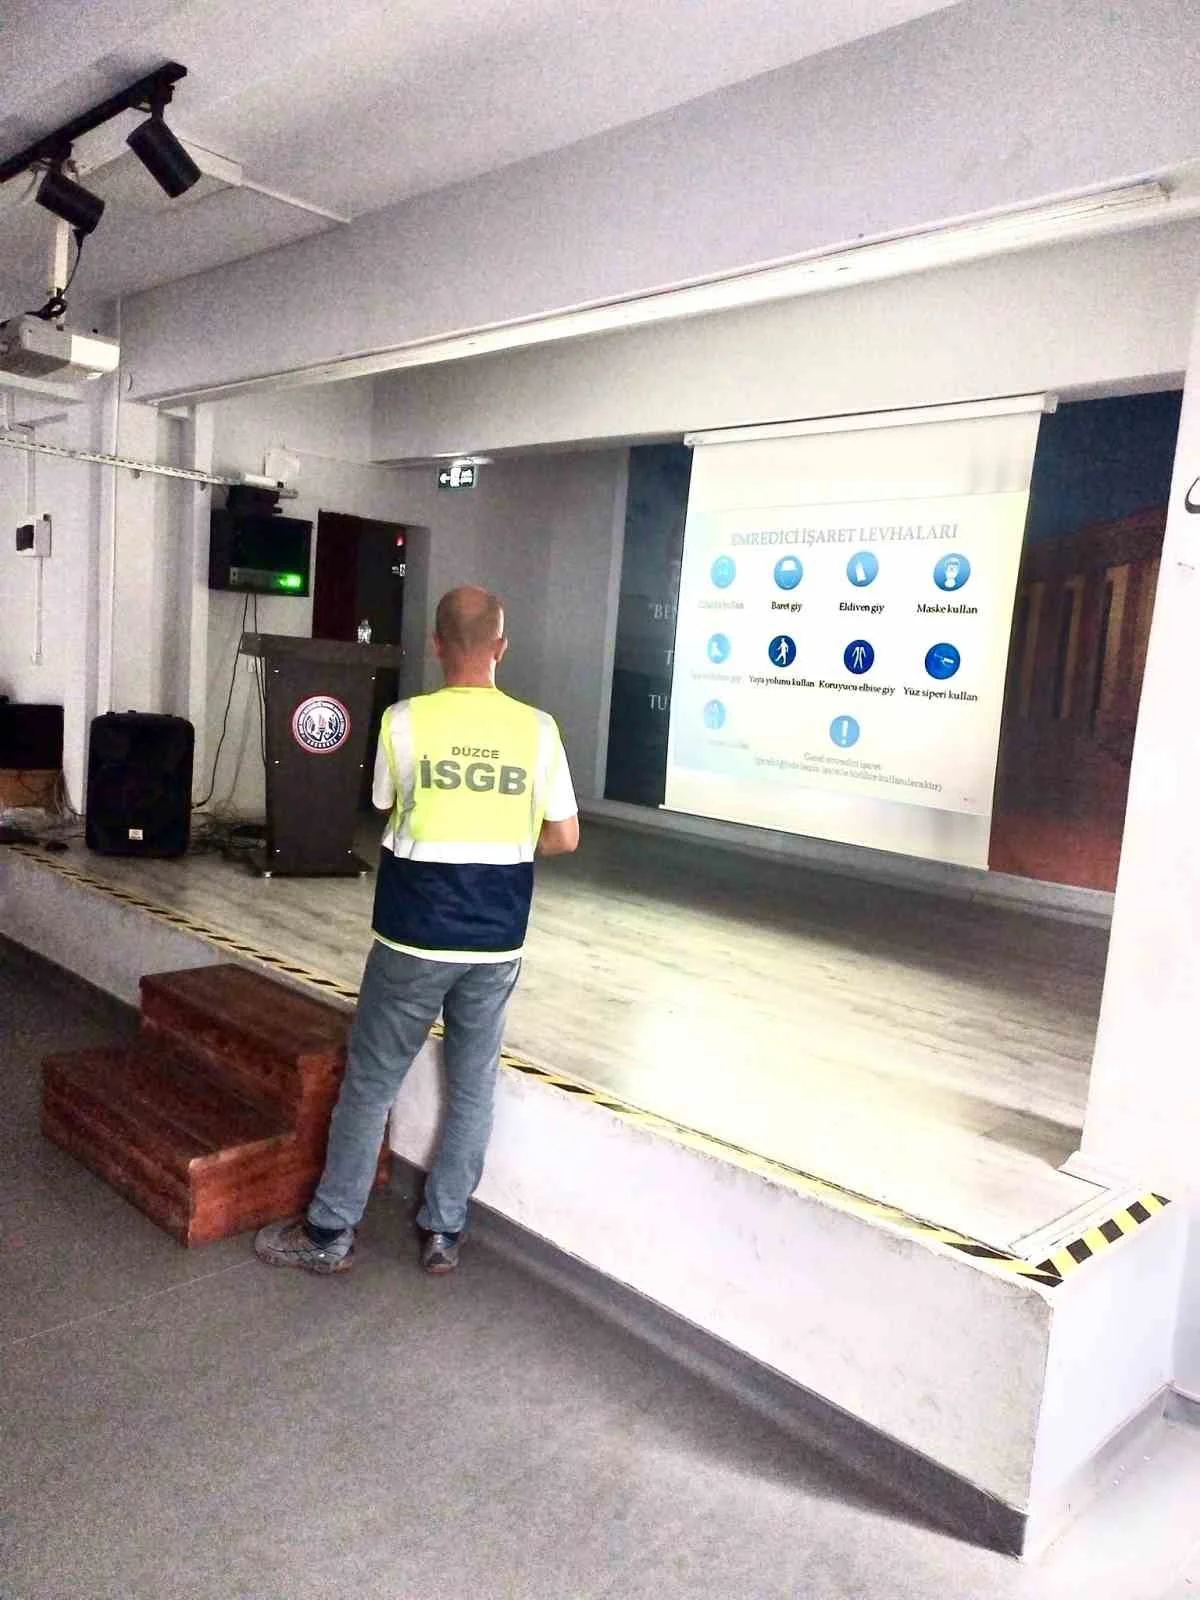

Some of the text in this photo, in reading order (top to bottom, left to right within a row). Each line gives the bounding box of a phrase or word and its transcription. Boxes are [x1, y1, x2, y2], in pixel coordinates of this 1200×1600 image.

[839, 601, 870, 612] Eldiven
[916, 603, 978, 615] Maske kullan
[791, 677, 815, 688] kullan
[818, 679, 858, 693] Koruyucu
[903, 686, 978, 703] Yüz siperi kullan
[419, 754, 527, 796] İSGB
